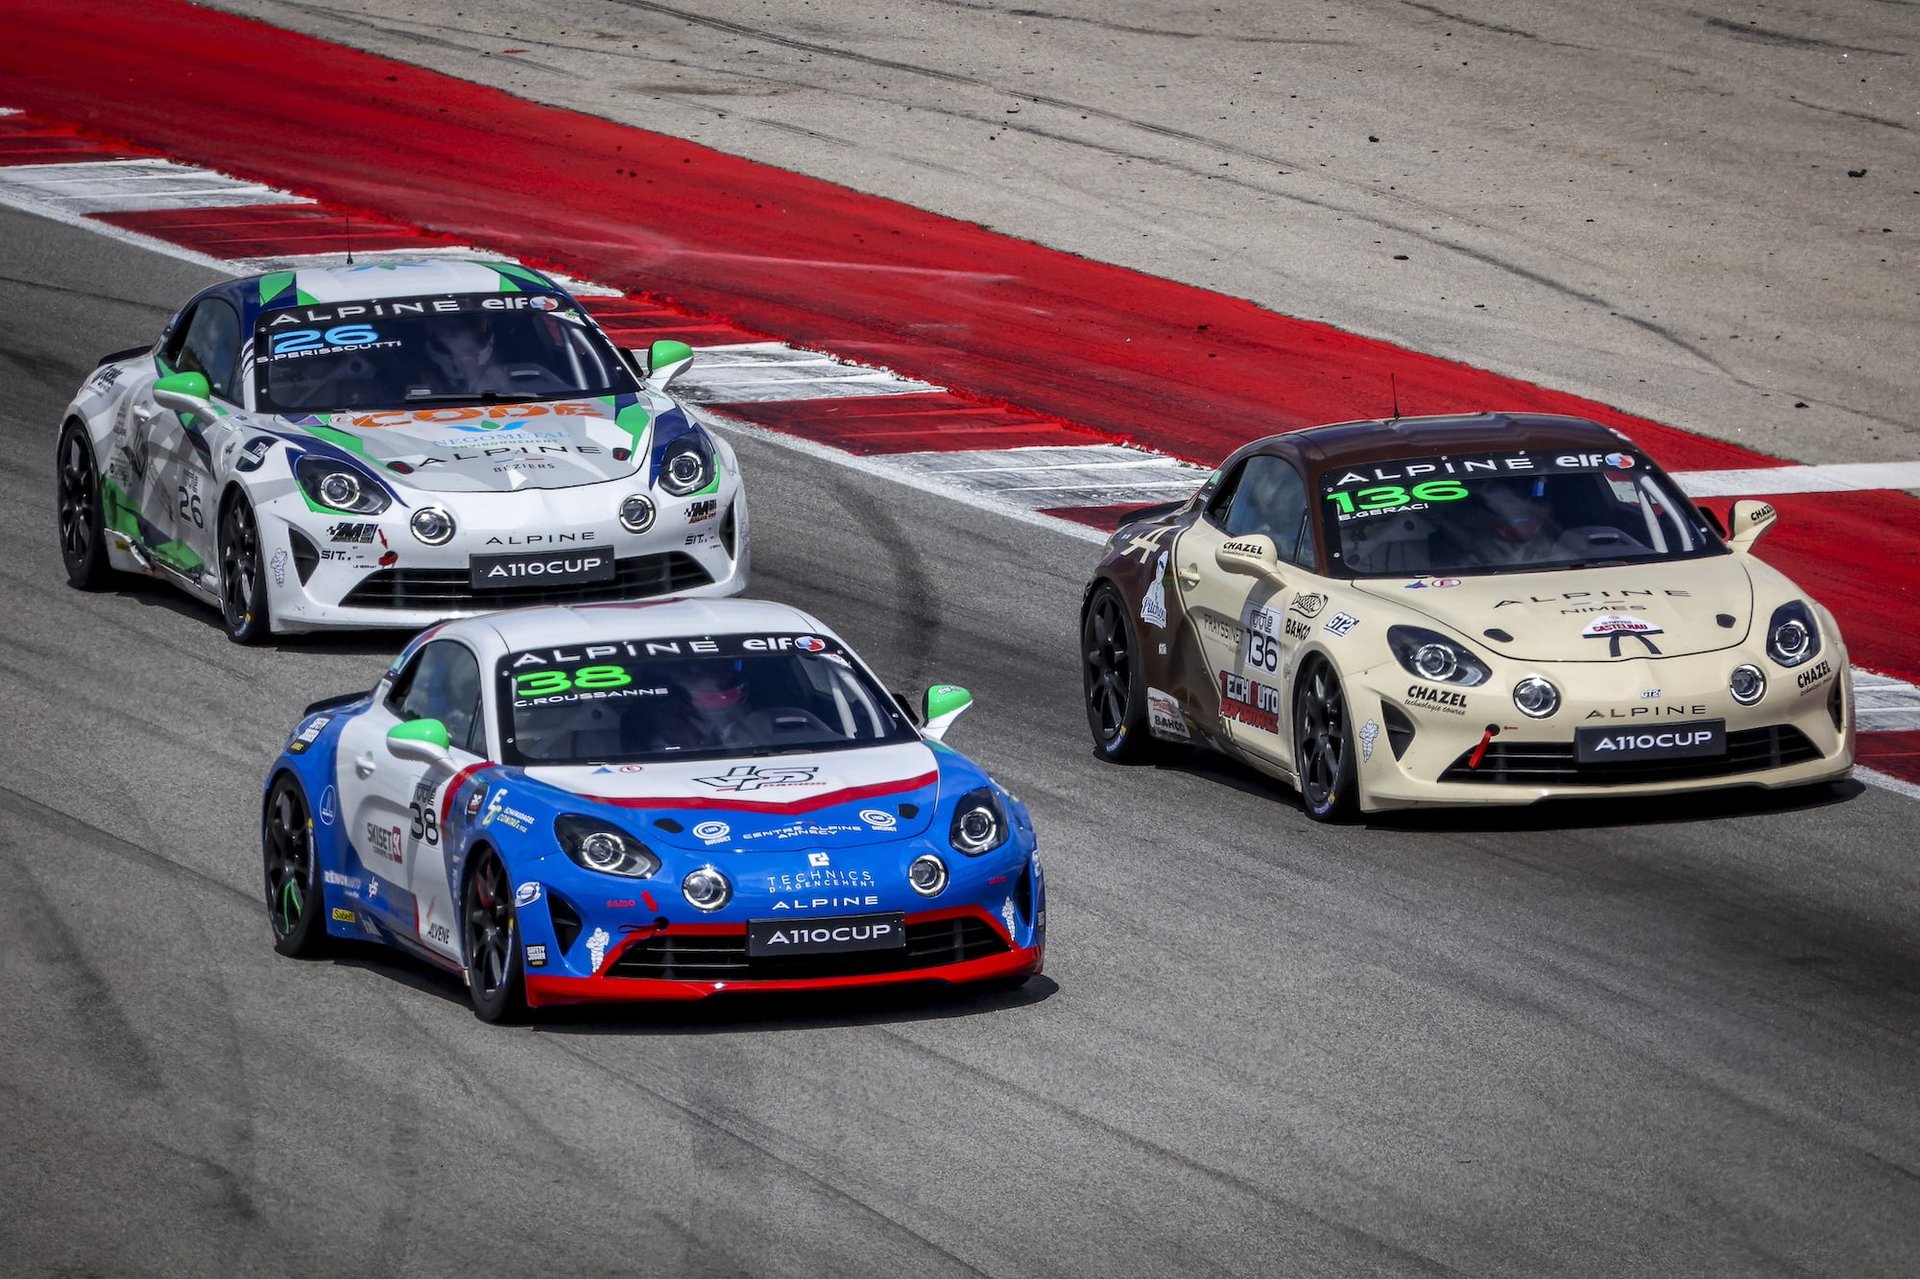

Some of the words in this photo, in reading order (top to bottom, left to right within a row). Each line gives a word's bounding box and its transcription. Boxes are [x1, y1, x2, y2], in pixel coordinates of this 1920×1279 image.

[270, 299, 460, 327] ALPINE
[482, 296, 530, 310] elf
[272, 324, 379, 354] 26
[419, 446, 601, 467] ALPINE
[1556, 454, 1606, 467] elf
[1336, 458, 1534, 486] ALPINE
[1327, 480, 1469, 513] 136
[178, 485, 203, 529] 26
[486, 531, 595, 545] ALPINE
[1223, 542, 1263, 554] CHAZEL
[487, 557, 601, 579] A110CUP
[1493, 590, 1692, 609] ALPINE
[513, 640, 720, 668] ALPINE
[742, 637, 793, 651] elf
[1246, 627, 1278, 673] 136
[517, 665, 632, 697] 38
[1797, 660, 1831, 689] CHAZEL
[514, 688, 669, 707] C.ROUSSANNE
[1407, 685, 1467, 708] CHAZEL
[1586, 704, 1706, 720] ALPINE
[1155, 715, 1186, 733] BAHCO
[1594, 731, 1712, 751] A110CUP
[409, 802, 439, 846] 38
[743, 826, 803, 840] CENTRE
[778, 829, 838, 839] ANNECY
[768, 871, 872, 886] TECHNICS
[769, 880, 876, 894] D'AGENCEMENT
[772, 896, 878, 910] ALPINE
[767, 924, 891, 945] A110CUP
